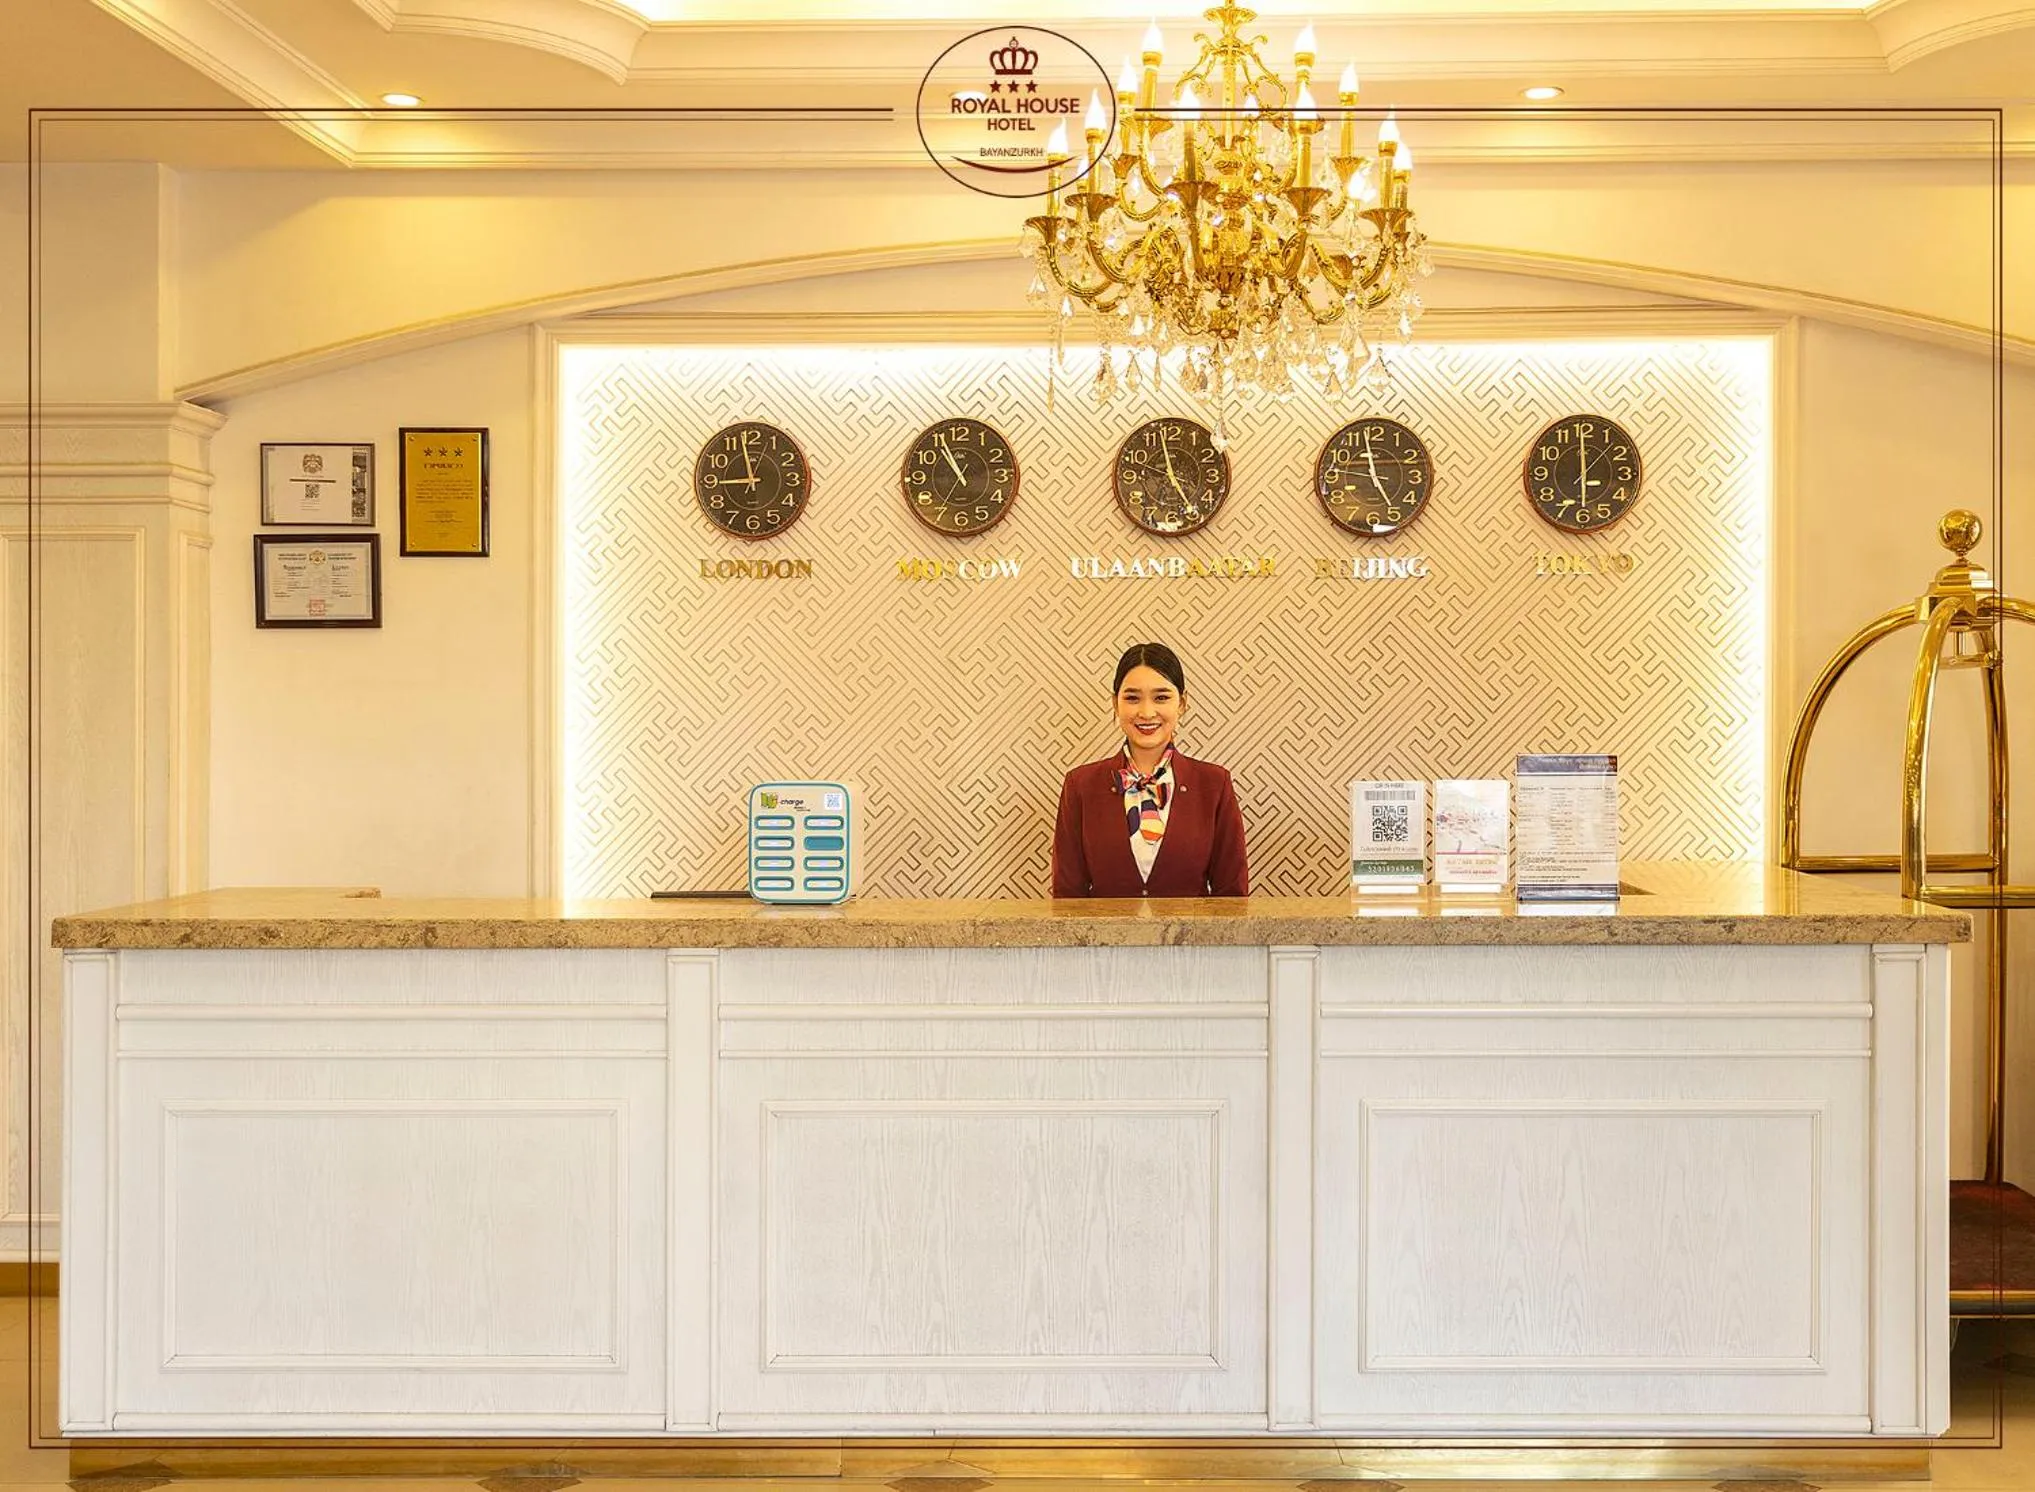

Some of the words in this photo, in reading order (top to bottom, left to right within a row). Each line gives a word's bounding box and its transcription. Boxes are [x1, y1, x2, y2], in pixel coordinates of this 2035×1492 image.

[742, 431, 761, 445] 12
[950, 427, 969, 441] 12
[1161, 426, 1181, 441] 12
[1364, 426, 1384, 441] 12
[1556, 429, 1568, 444] 11
[1574, 423, 1594, 438] 12
[724, 436, 737, 451] 11
[932, 432, 945, 447] 11
[1144, 432, 1156, 447] 11
[1346, 432, 1359, 447] 11
[781, 452, 795, 467] 2
[918, 450, 936, 465] 10
[989, 448, 1003, 464] 2
[1128, 450, 1147, 464] 10
[1201, 449, 1214, 464] 2
[1331, 449, 1350, 464] 10
[1404, 449, 1418, 464] 2
[1540, 446, 1559, 461] 10
[1613, 446, 1627, 461] 2
[707, 454, 728, 469] 10
[786, 472, 800, 486] 3
[912, 471, 926, 485] 9
[995, 468, 1008, 483] 3
[1122, 470, 1136, 484] 9
[1206, 469, 1219, 484] 3
[1325, 469, 1339, 484] 9
[1408, 470, 1422, 484] 3
[1534, 466, 1548, 481] 9
[1618, 466, 1632, 481] 3
[704, 474, 718, 489] 9
[781, 493, 795, 507] 4
[918, 491, 932, 506] 8
[990, 489, 1004, 503] 4
[1129, 491, 1143, 504] 8
[1201, 489, 1214, 504] 4
[1331, 490, 1344, 504] 8
[1402, 491, 1416, 505] 4
[1540, 487, 1554, 501] 8
[1612, 487, 1626, 501] 4
[710, 495, 724, 509] 8
[726, 511, 739, 524] 7
[766, 510, 780, 524] 5
[935, 507, 947, 521] 7
[975, 506, 988, 521] 5
[1145, 507, 1157, 522] 7
[1165, 511, 1178, 524] 6
[1347, 507, 1359, 521] 7
[1387, 507, 1400, 522] 5
[1556, 503, 1571, 518] 7
[1576, 509, 1590, 523] 6
[1597, 504, 1611, 518] 5
[746, 515, 760, 530] 6
[954, 511, 968, 526] 6
[1366, 512, 1380, 526] 6
[699, 558, 813, 579] LONDON
[897, 557, 1022, 580] MOSCOW
[1070, 556, 1277, 578] ULAANBAATAR
[1315, 556, 1429, 579] BEIJING
[1534, 553, 1634, 575] TOKYO
